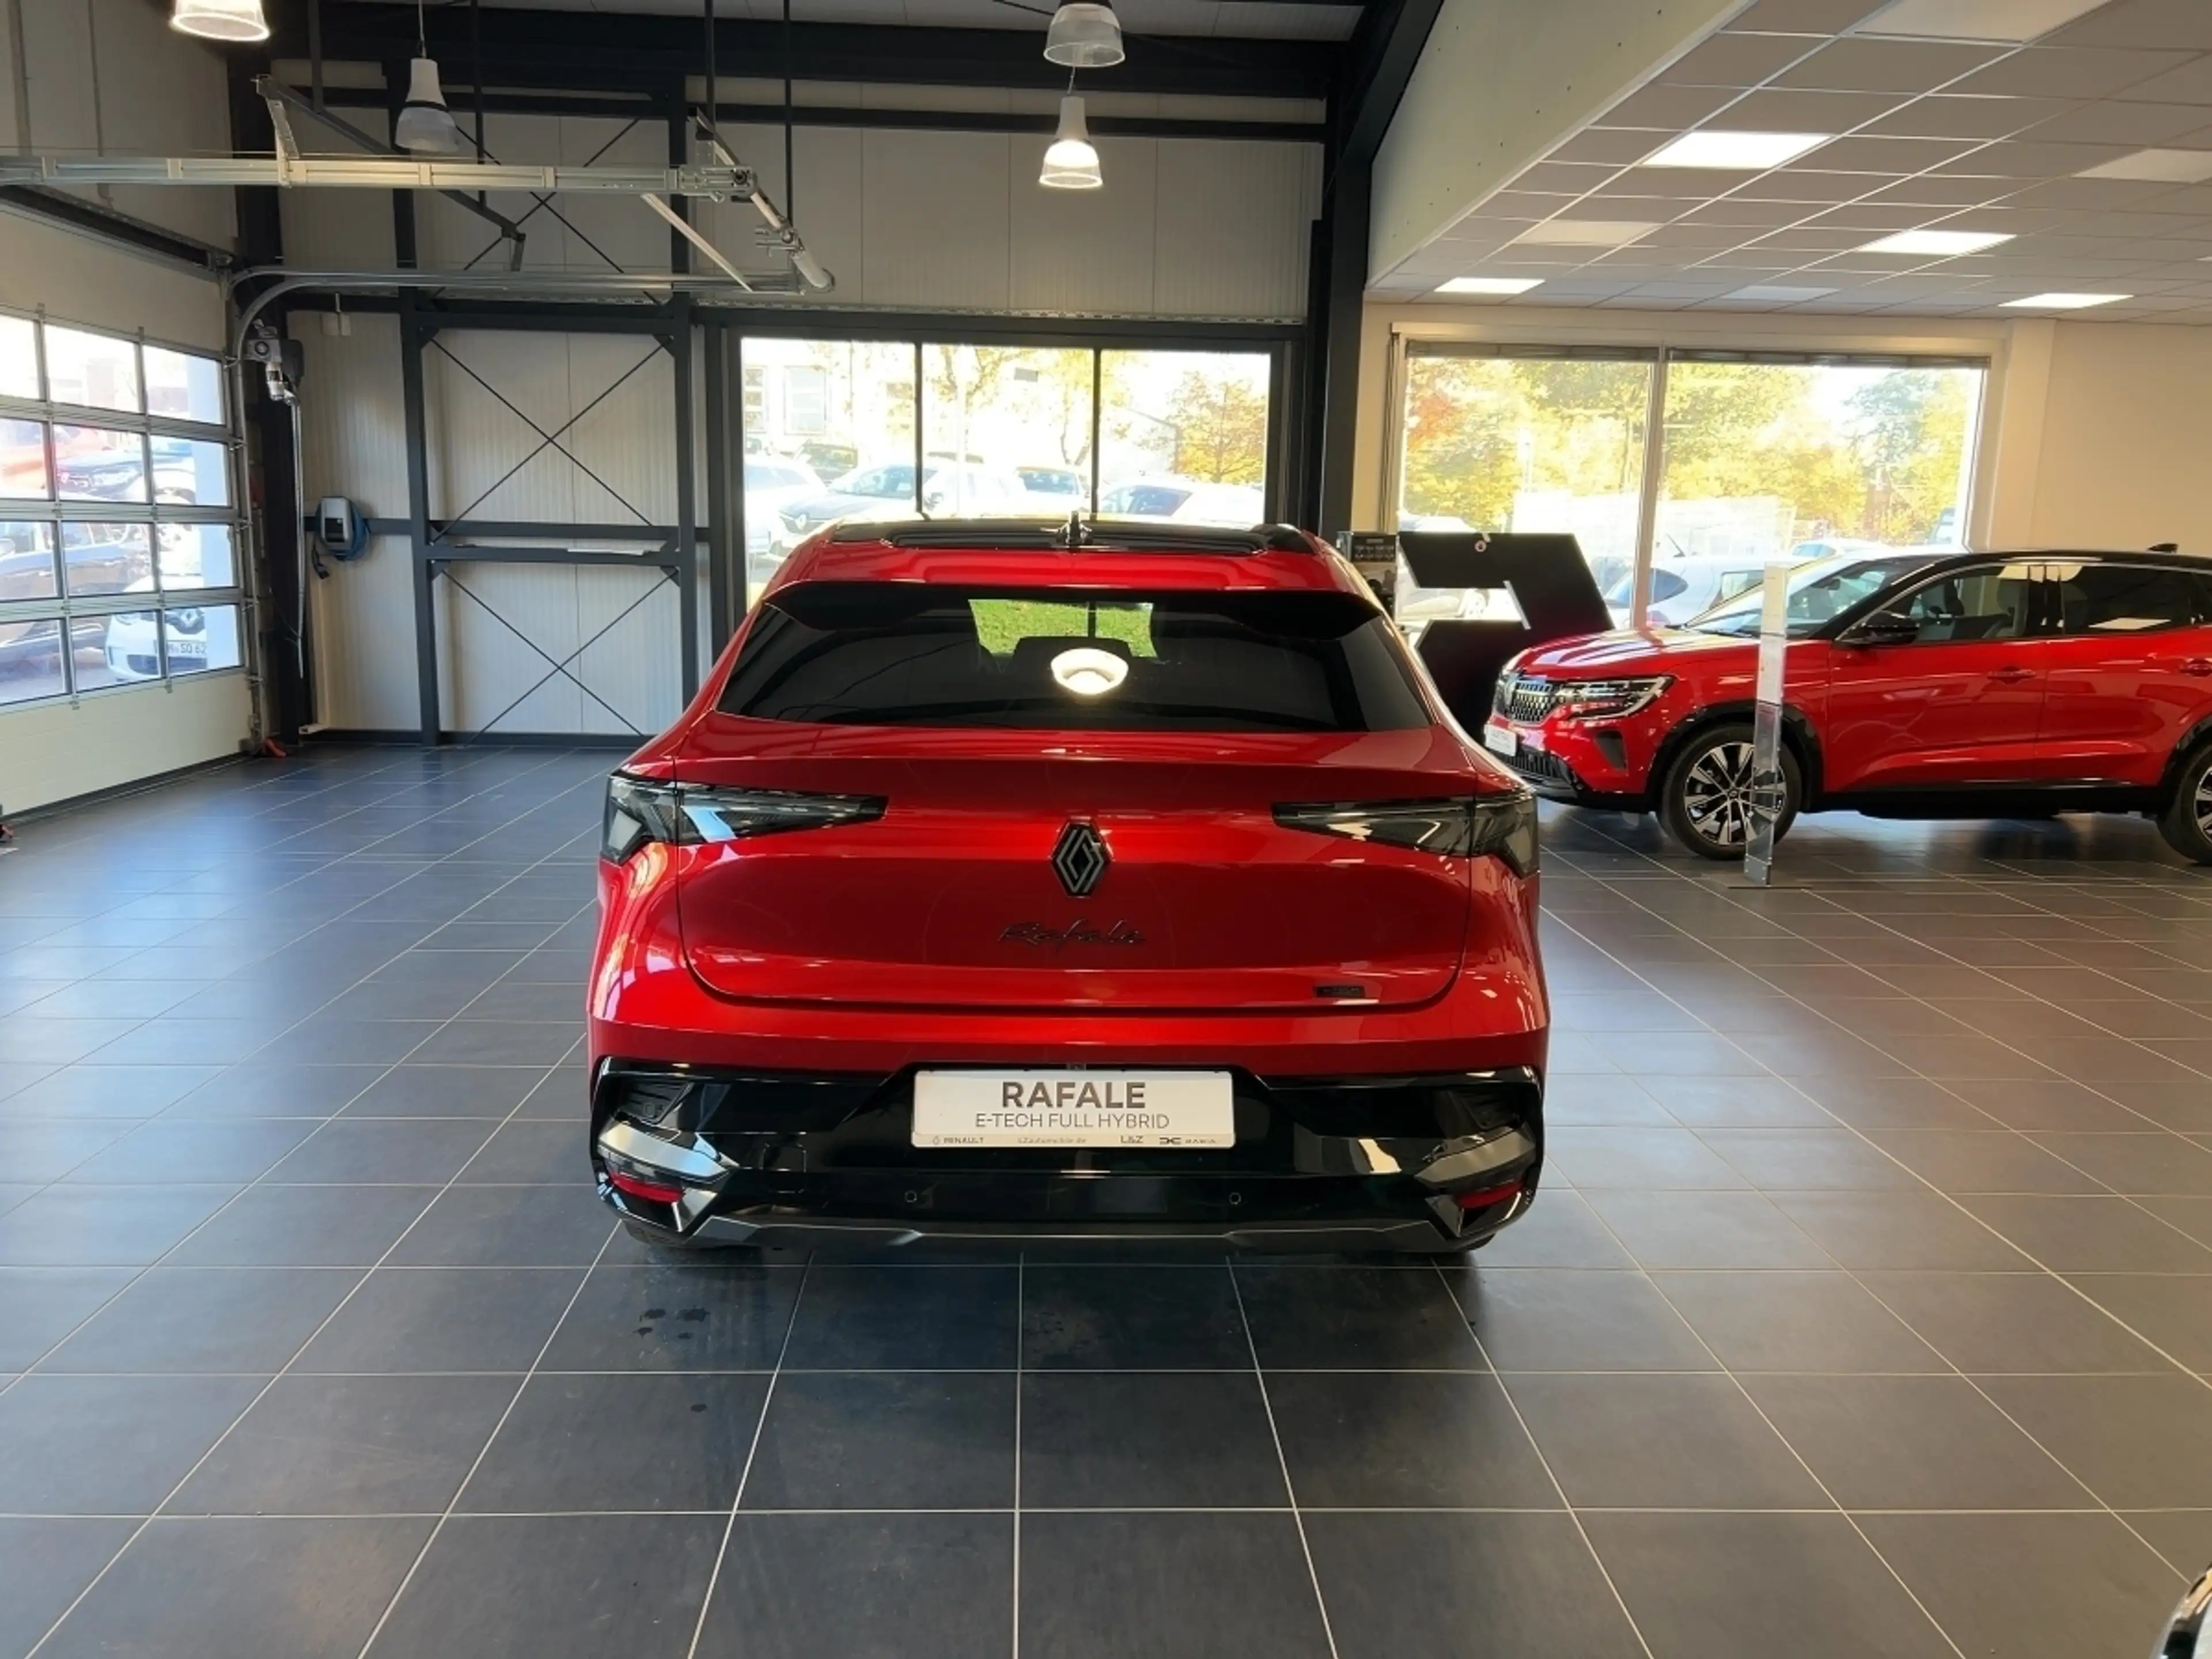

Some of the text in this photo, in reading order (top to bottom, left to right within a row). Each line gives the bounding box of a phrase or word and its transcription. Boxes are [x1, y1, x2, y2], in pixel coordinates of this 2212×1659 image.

[1001, 1081, 1146, 1109] RAFALE
[975, 1113, 1170, 1129] E-TECH FULL HYBRID
